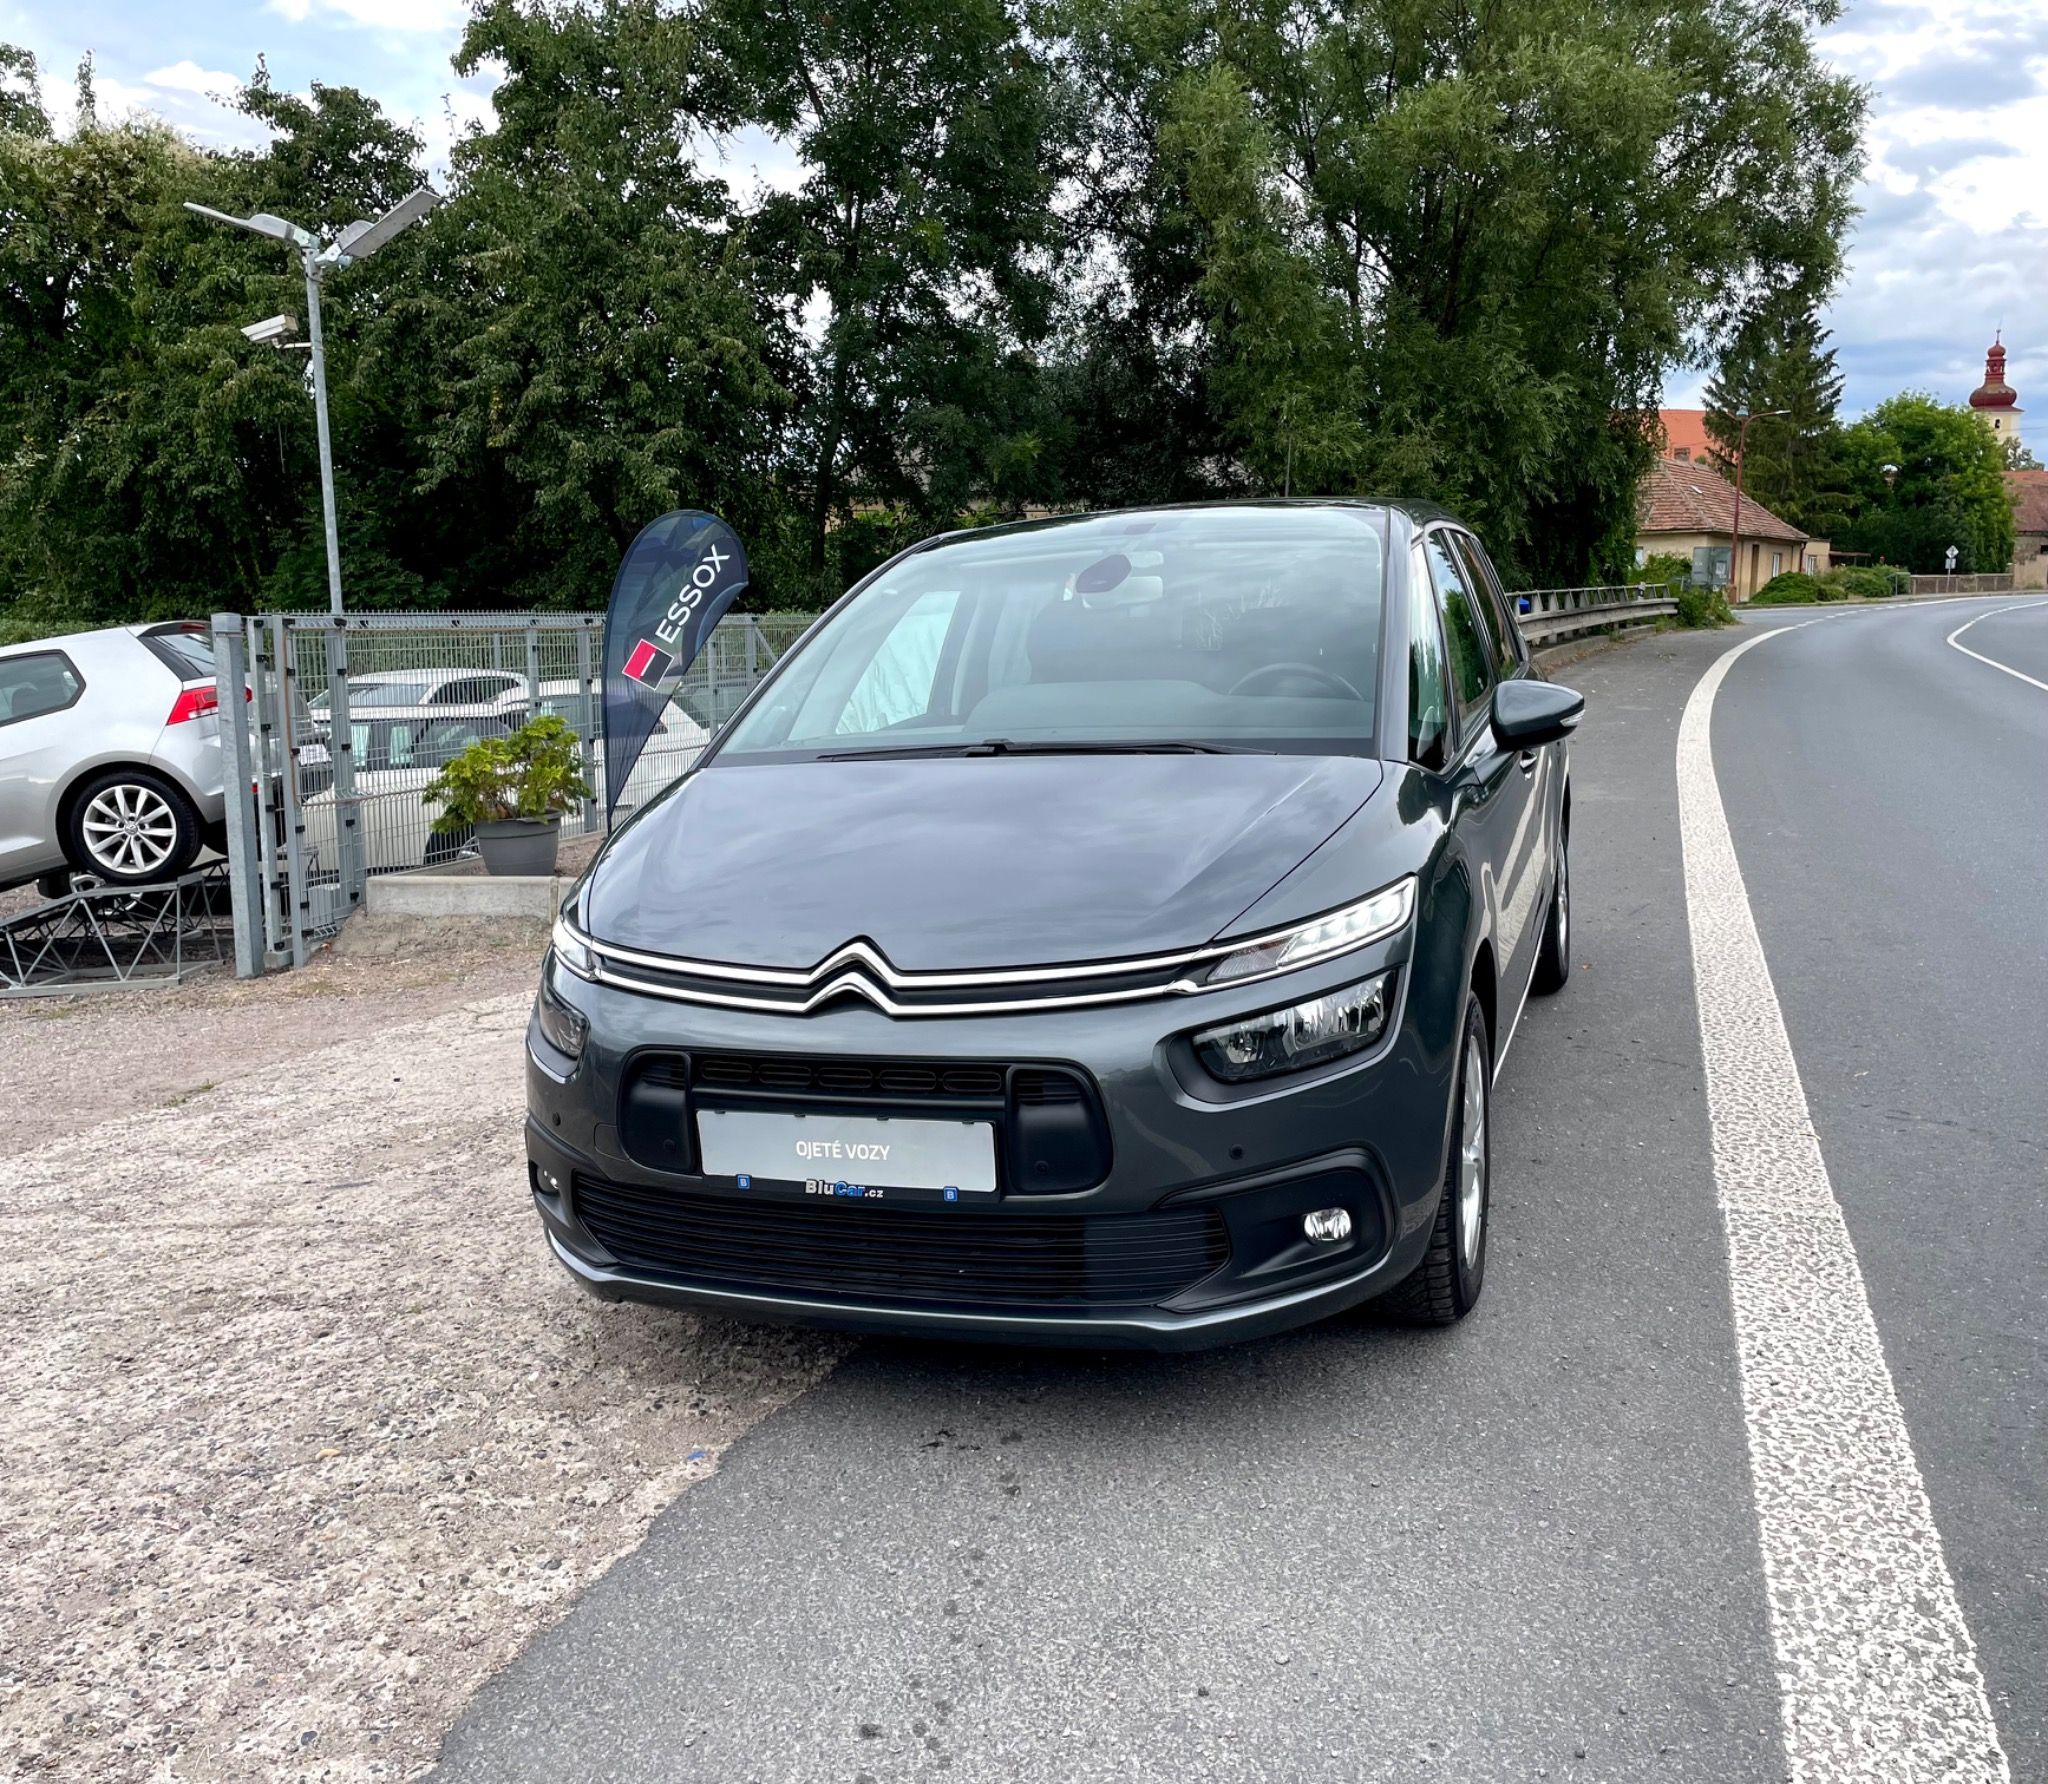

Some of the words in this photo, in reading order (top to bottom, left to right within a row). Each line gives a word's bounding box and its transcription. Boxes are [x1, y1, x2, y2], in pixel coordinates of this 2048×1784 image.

[655, 543, 730, 644] ESSOX
[796, 1139, 843, 1160] OJETÉ
[845, 1143, 890, 1161] VOZY
[804, 1178, 885, 1199] BluCar.cz
